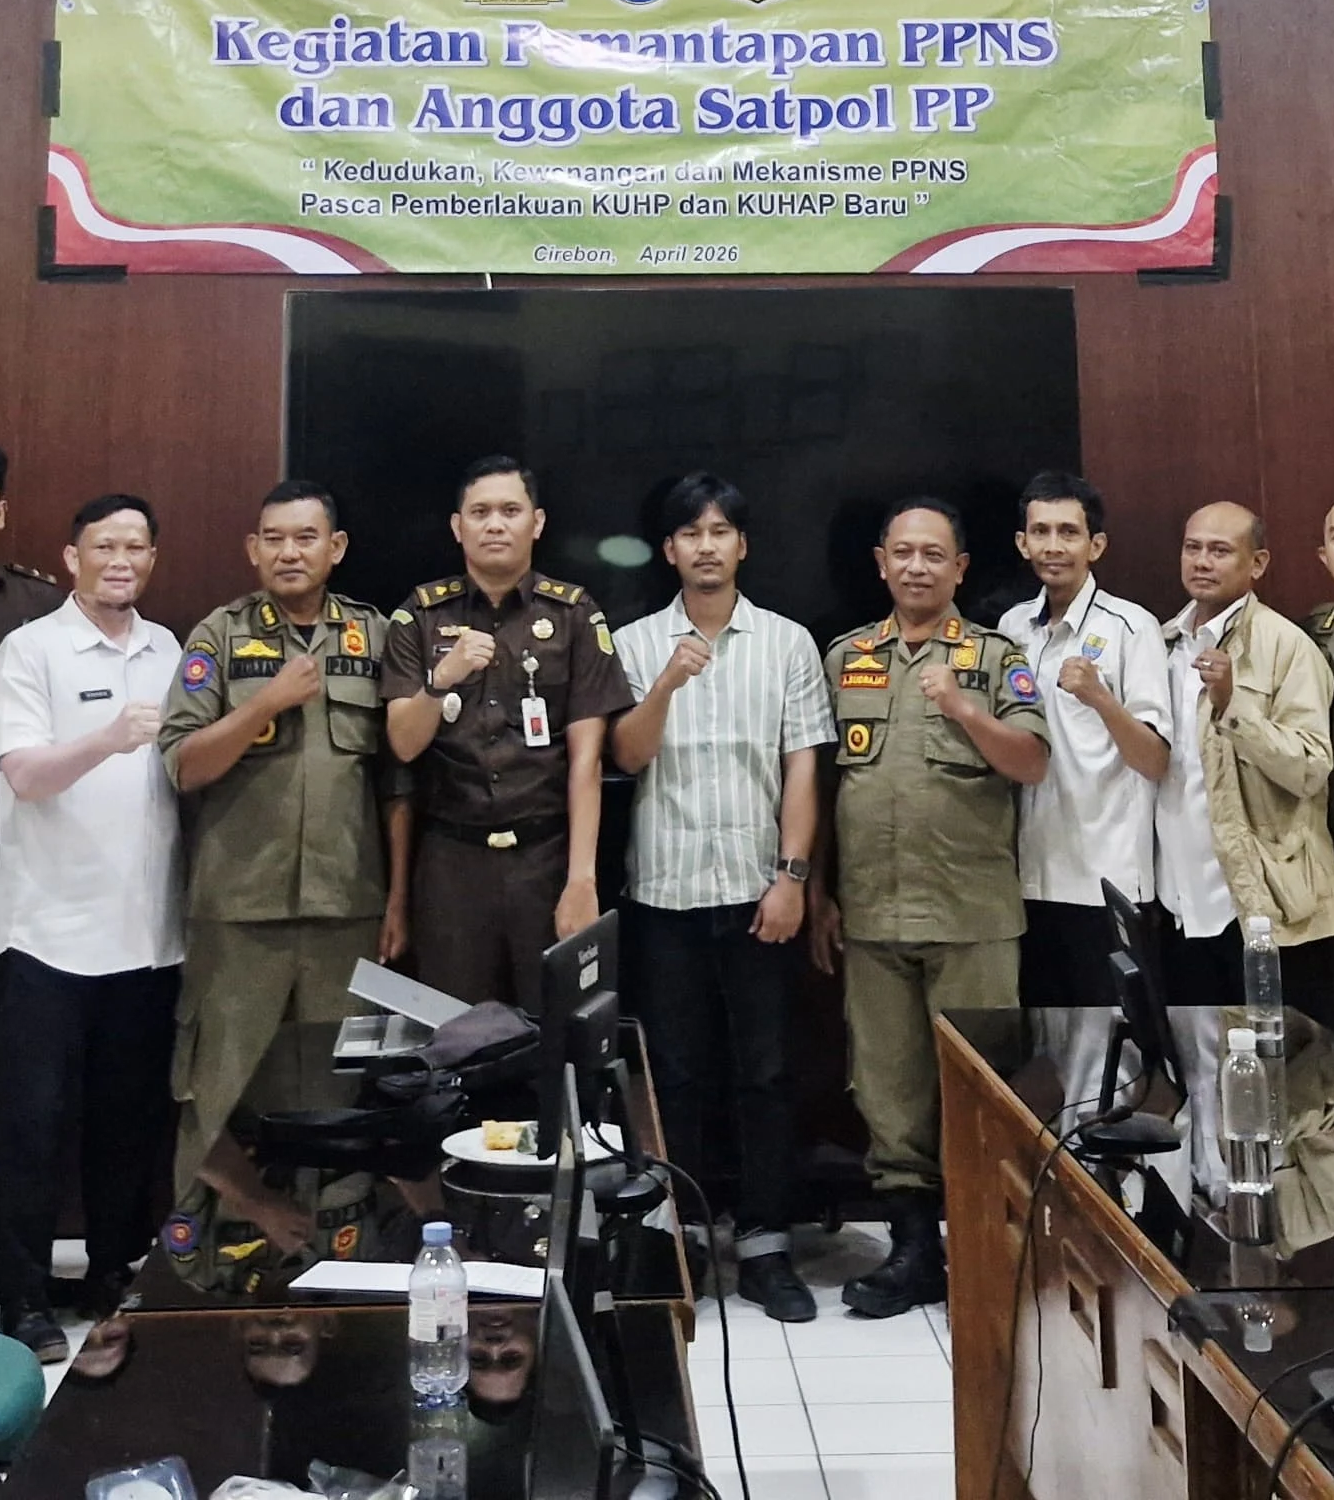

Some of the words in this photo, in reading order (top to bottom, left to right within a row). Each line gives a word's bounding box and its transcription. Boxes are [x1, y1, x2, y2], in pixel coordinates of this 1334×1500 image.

[215, 18, 484, 74] Kegiatan
[504, 19, 882, 75] Pmantapan
[902, 21, 1054, 62] PPNS
[280, 86, 390, 128] dan
[415, 85, 675, 142] Anggota
[697, 86, 891, 139] Satpol
[912, 87, 991, 128] PP
[323, 159, 484, 185] Kedudukan,
[674, 161, 724, 182] dan
[732, 160, 884, 181] Mekanisme
[891, 159, 967, 181] PPNS
[300, 193, 382, 215] Pasca
[391, 193, 583, 215] Pemberlakuan
[592, 193, 670, 215] KUHP
[679, 193, 728, 215] dan
[737, 193, 836, 215] KUHAP
[844, 193, 907, 215] Baru
[533, 246, 617, 265] Cirebon,
[639, 246, 687, 265] April
[693, 246, 739, 262] 2026
